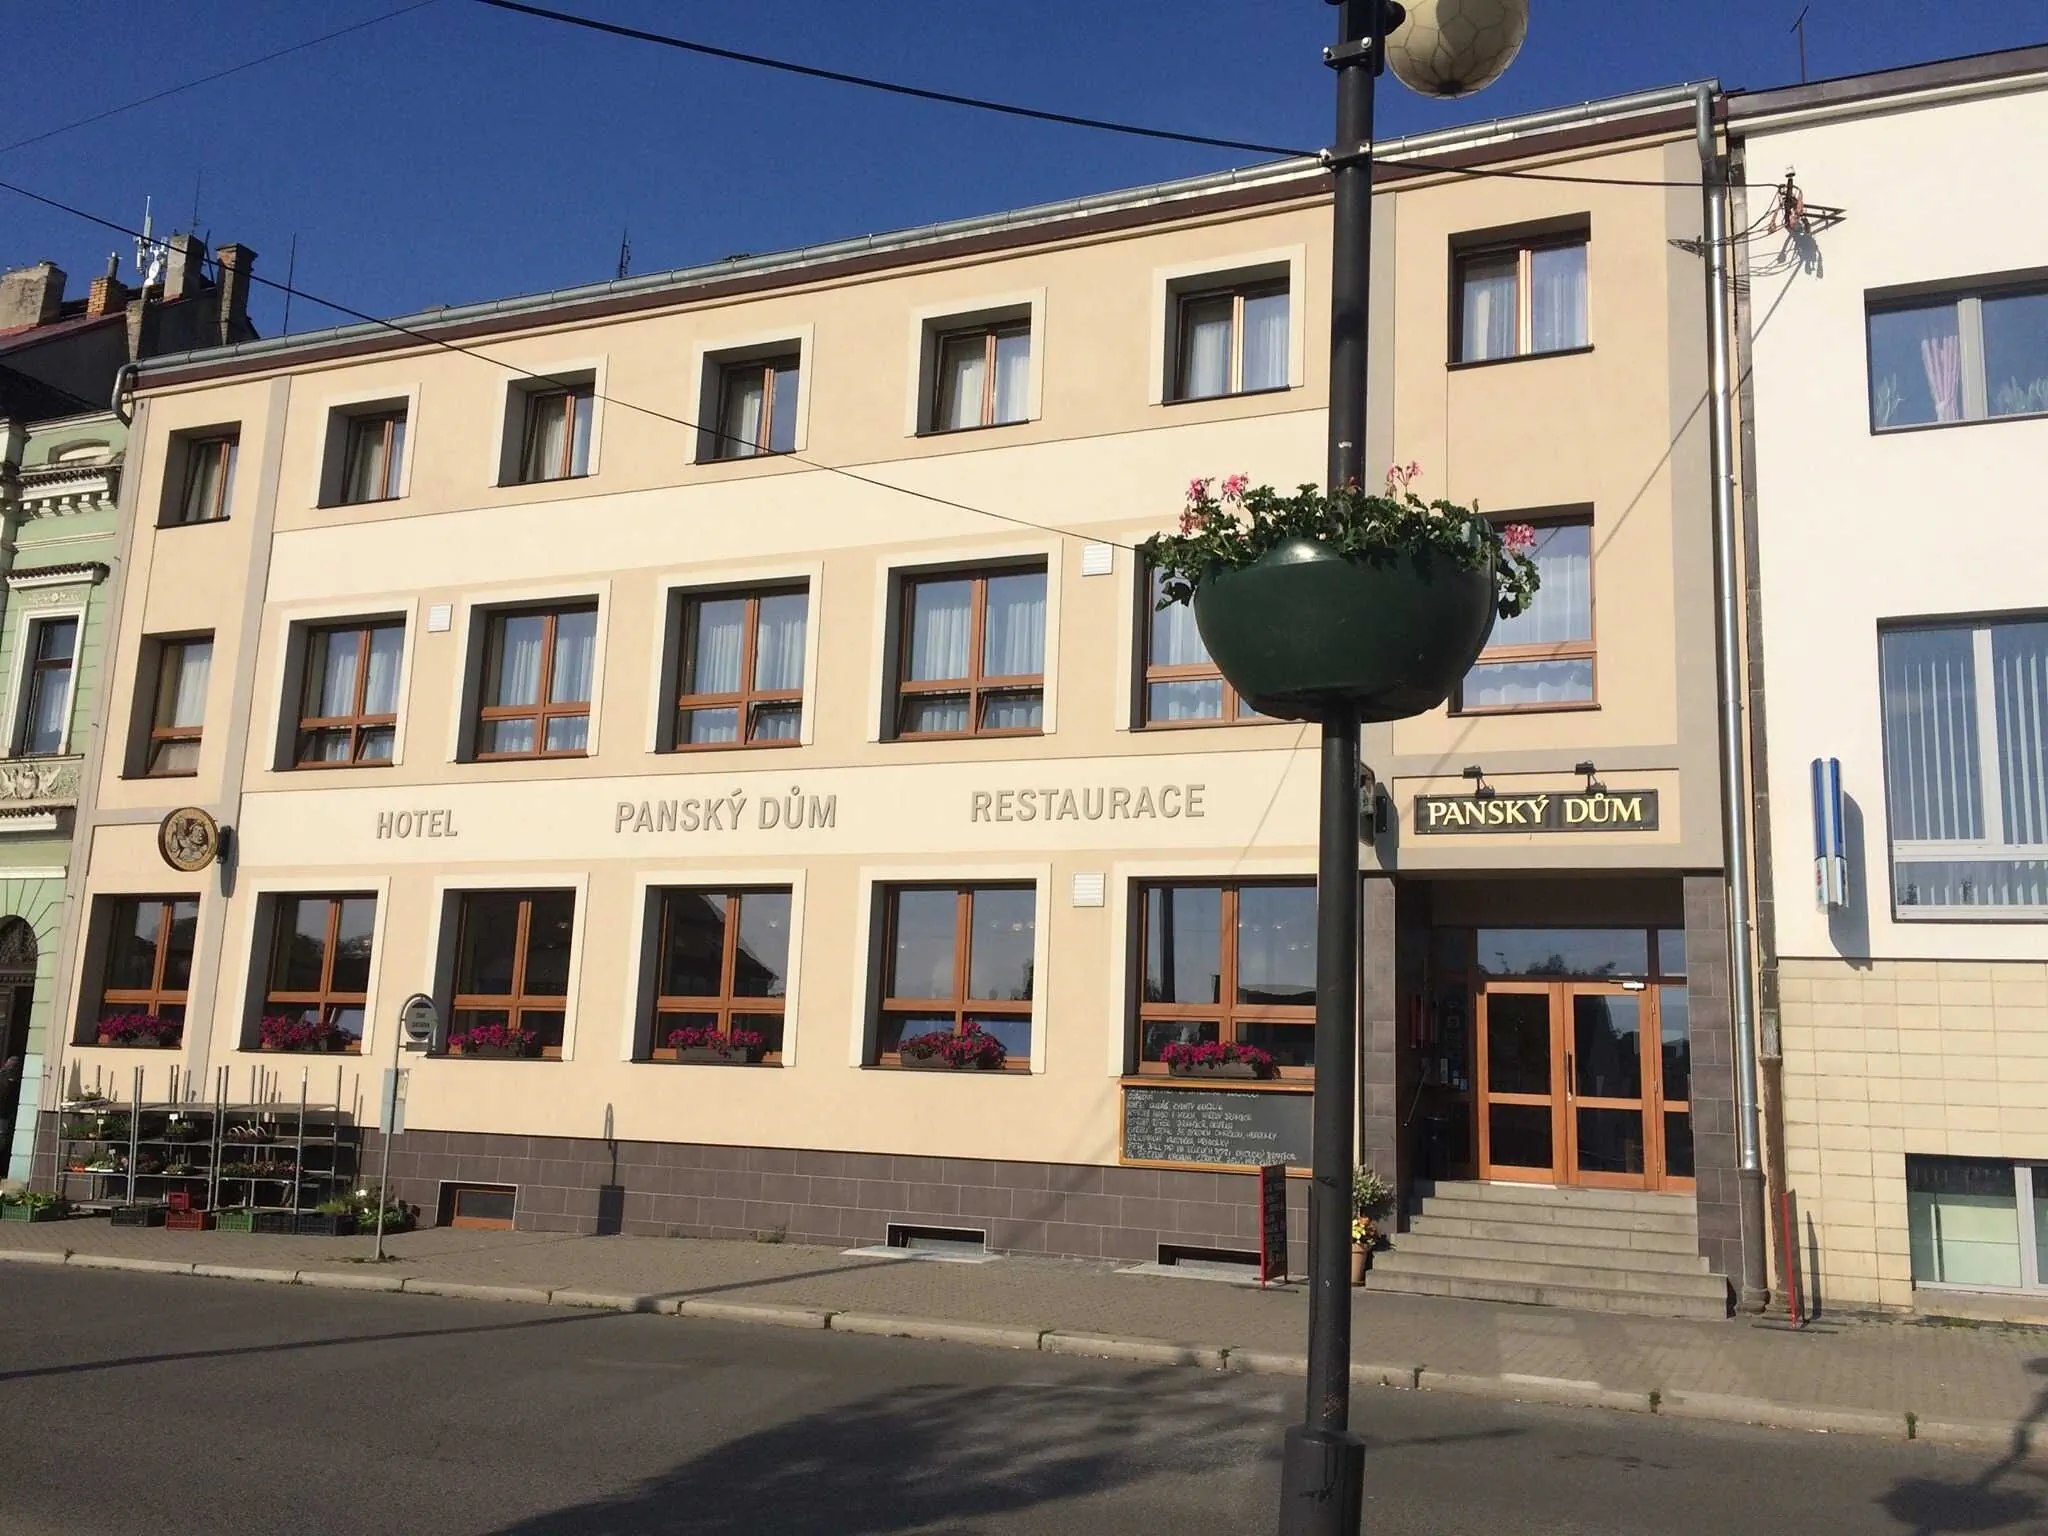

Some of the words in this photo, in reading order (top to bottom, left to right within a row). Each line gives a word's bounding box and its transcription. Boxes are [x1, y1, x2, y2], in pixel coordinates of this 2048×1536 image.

[376, 809, 458, 839] HOTEL
[614, 788, 747, 833] PANSKÝ
[757, 785, 838, 829] DŮM
[970, 783, 1206, 823] RESTAURACE
[1427, 795, 1549, 826] PANSKÝ
[1563, 793, 1642, 824] DŮM
